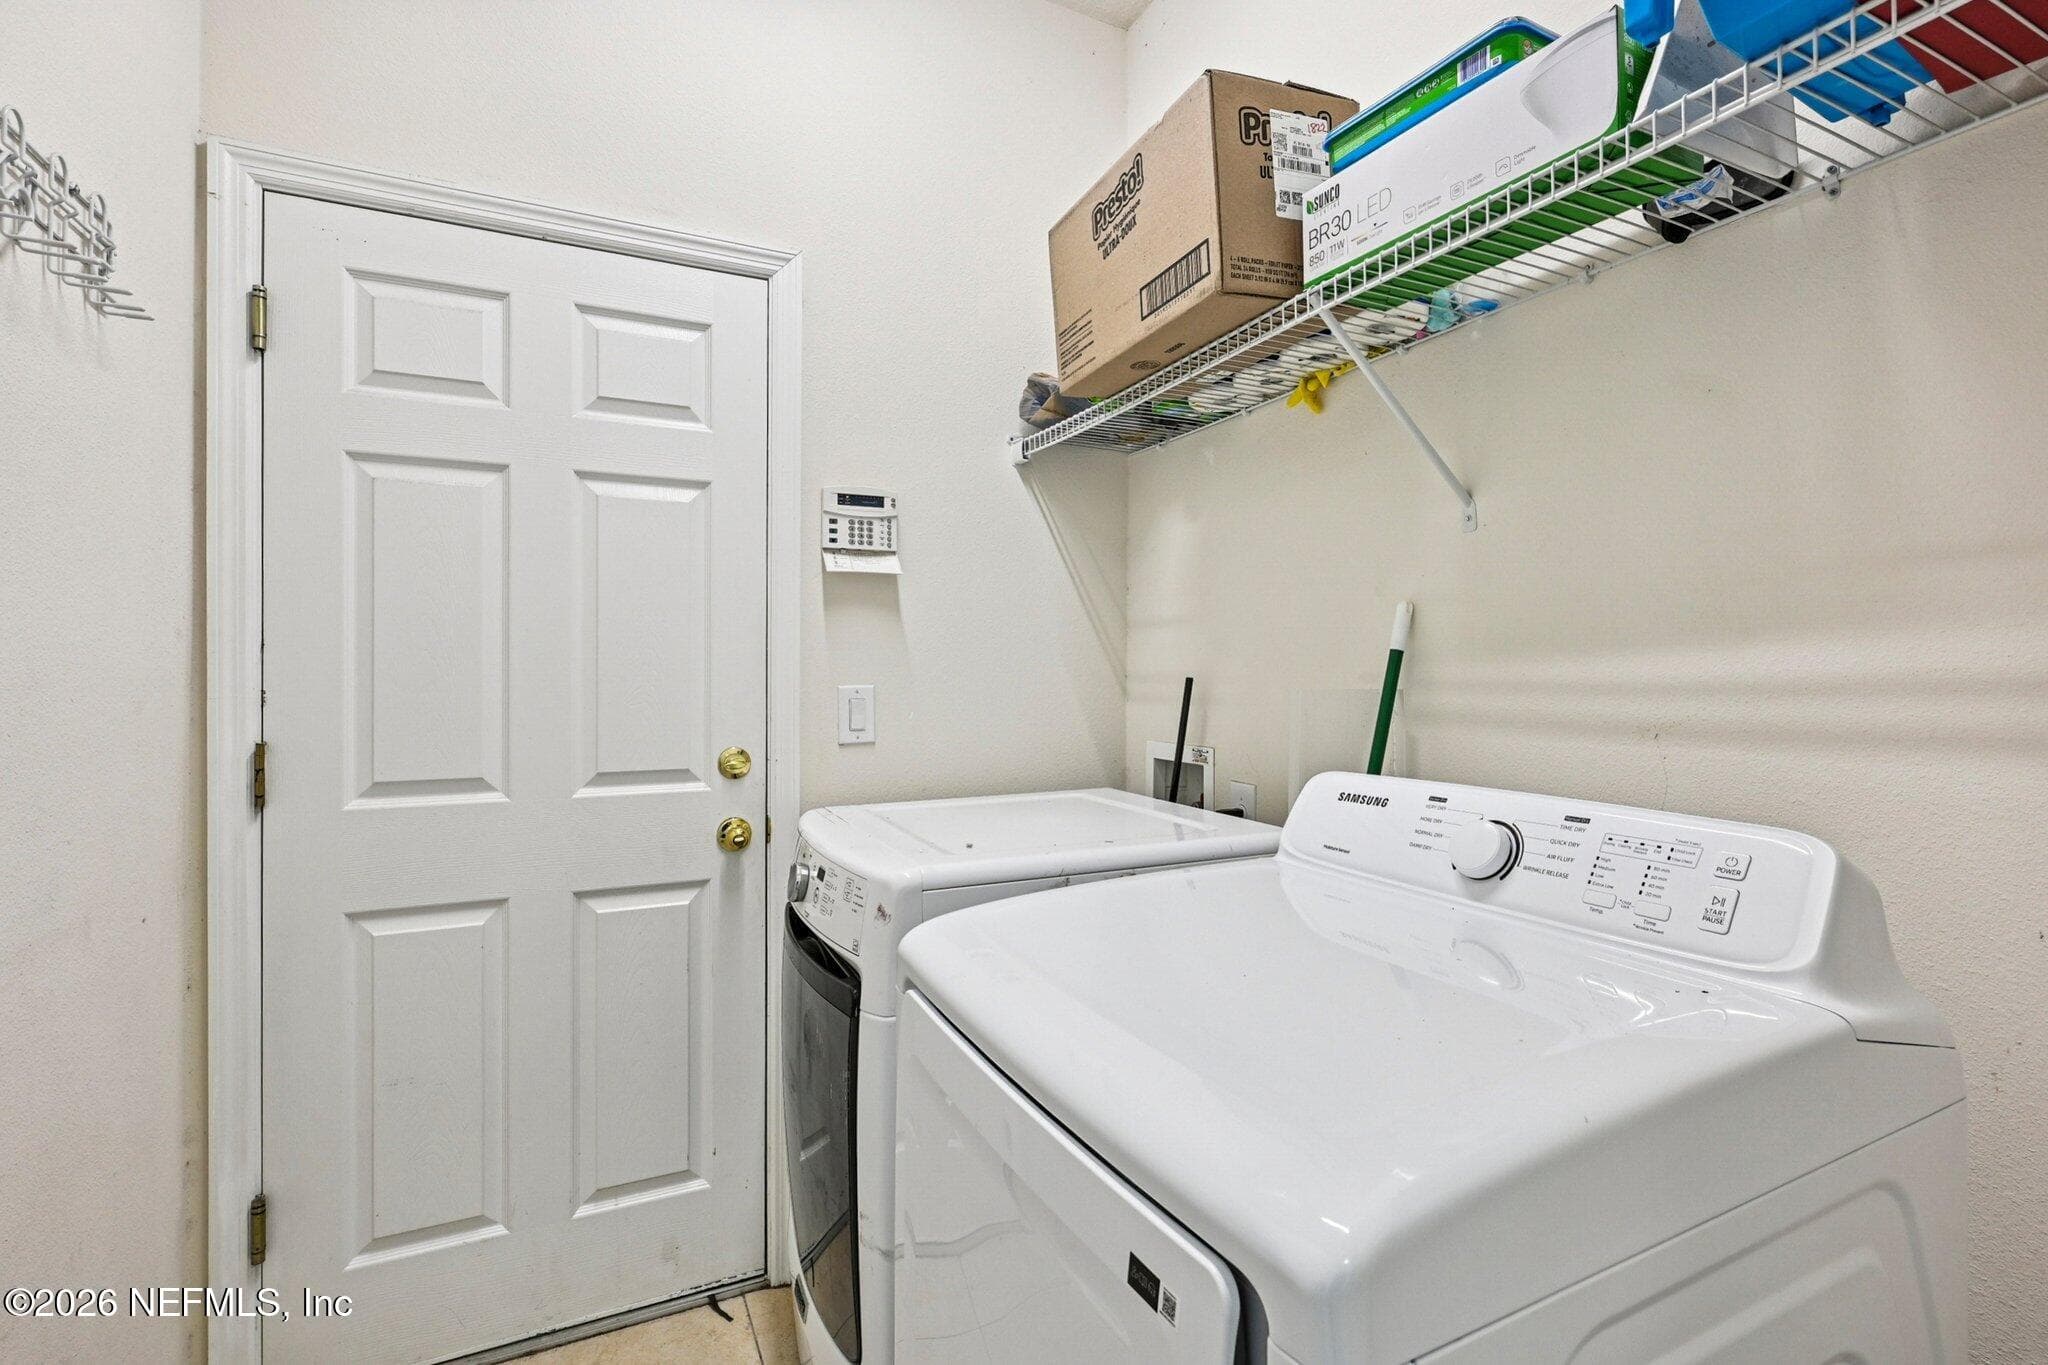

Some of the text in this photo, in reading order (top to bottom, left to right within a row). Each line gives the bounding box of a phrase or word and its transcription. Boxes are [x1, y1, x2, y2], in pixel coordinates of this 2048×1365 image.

[1092, 153, 1144, 241] Presto!
[1314, 183, 1340, 211] SUNCO
[1309, 209, 1352, 250] BR30
[1357, 187, 1392, 224] LED
[1329, 238, 1345, 254] 11W
[1309, 250, 1325, 267] 850
[1338, 792, 1390, 808] SAMSUNG
[1560, 824, 1573, 832] TIME
[1549, 838, 1580, 848] QUICK DRY
[1556, 855, 1576, 863] FLUFF
[1522, 865, 1569, 880] WRINKLE RELEASE
[1716, 866, 1742, 876] POWER
[1704, 907, 1727, 917] START
[1643, 919, 1657, 927] Time
[1702, 915, 1725, 925] PAUSE
